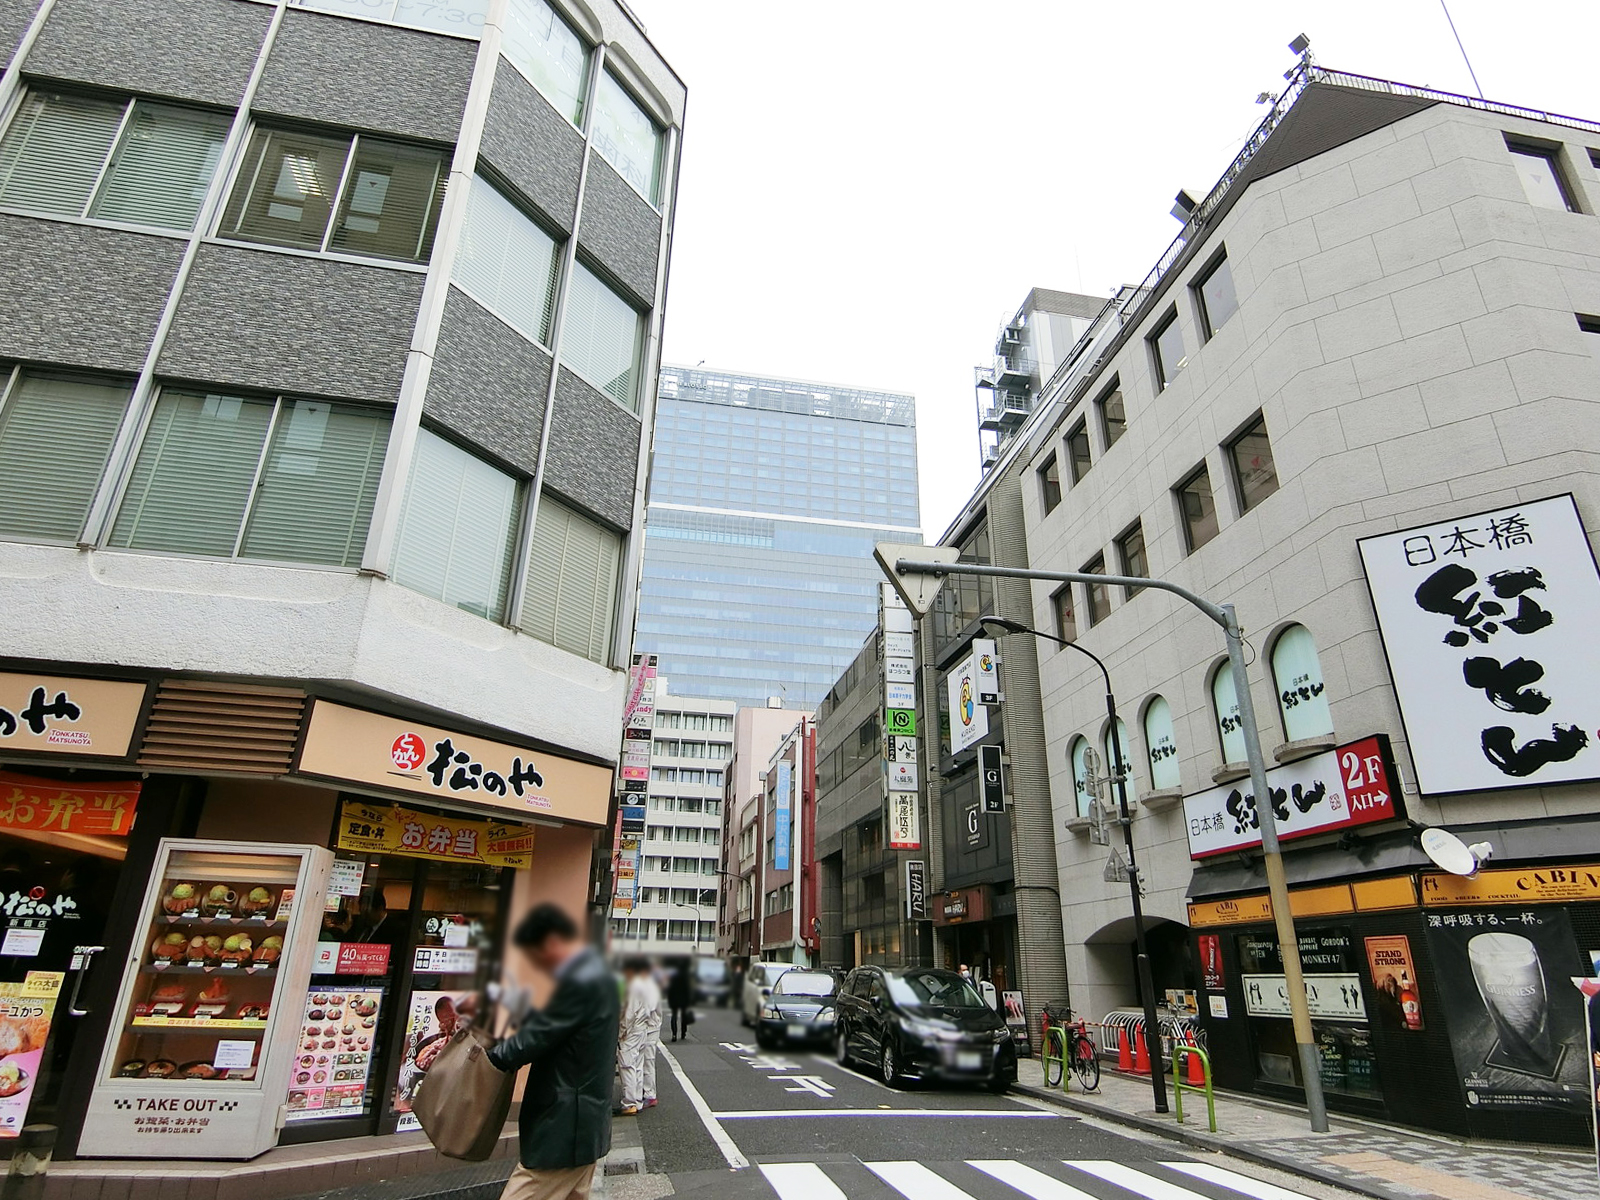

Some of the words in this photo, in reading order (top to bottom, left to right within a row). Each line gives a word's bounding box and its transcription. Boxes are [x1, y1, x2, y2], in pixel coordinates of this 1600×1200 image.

[1402, 513, 1534, 567] 日本橋
[48, 736, 91, 745] MATSUNOYA
[51, 729, 89, 738] TONKATSU
[427, 738, 544, 797] 松のや
[986, 770, 997, 782] G
[1342, 752, 1382, 789] 2F
[0, 788, 130, 831] お弁当
[1351, 793, 1374, 812] 入口
[968, 809, 979, 834] G
[1190, 812, 1225, 837] 日本橋
[401, 821, 479, 857] お弁当
[1516, 869, 1600, 892] CABIN
[3, 891, 77, 917] 松のや
[911, 873, 924, 913] HARU
[1428, 912, 1544, 928] 深呼吸する、一杯。
[1302, 954, 1331, 964] MONKEY
[1375, 950, 1402, 958] STAND
[1375, 958, 1406, 966] STRONG
[1485, 983, 1536, 997] GUINNESS
[422, 1005, 433, 1035] 松のや
[136, 1098, 180, 1111] TAKE
[183, 1099, 217, 1111] OUT
